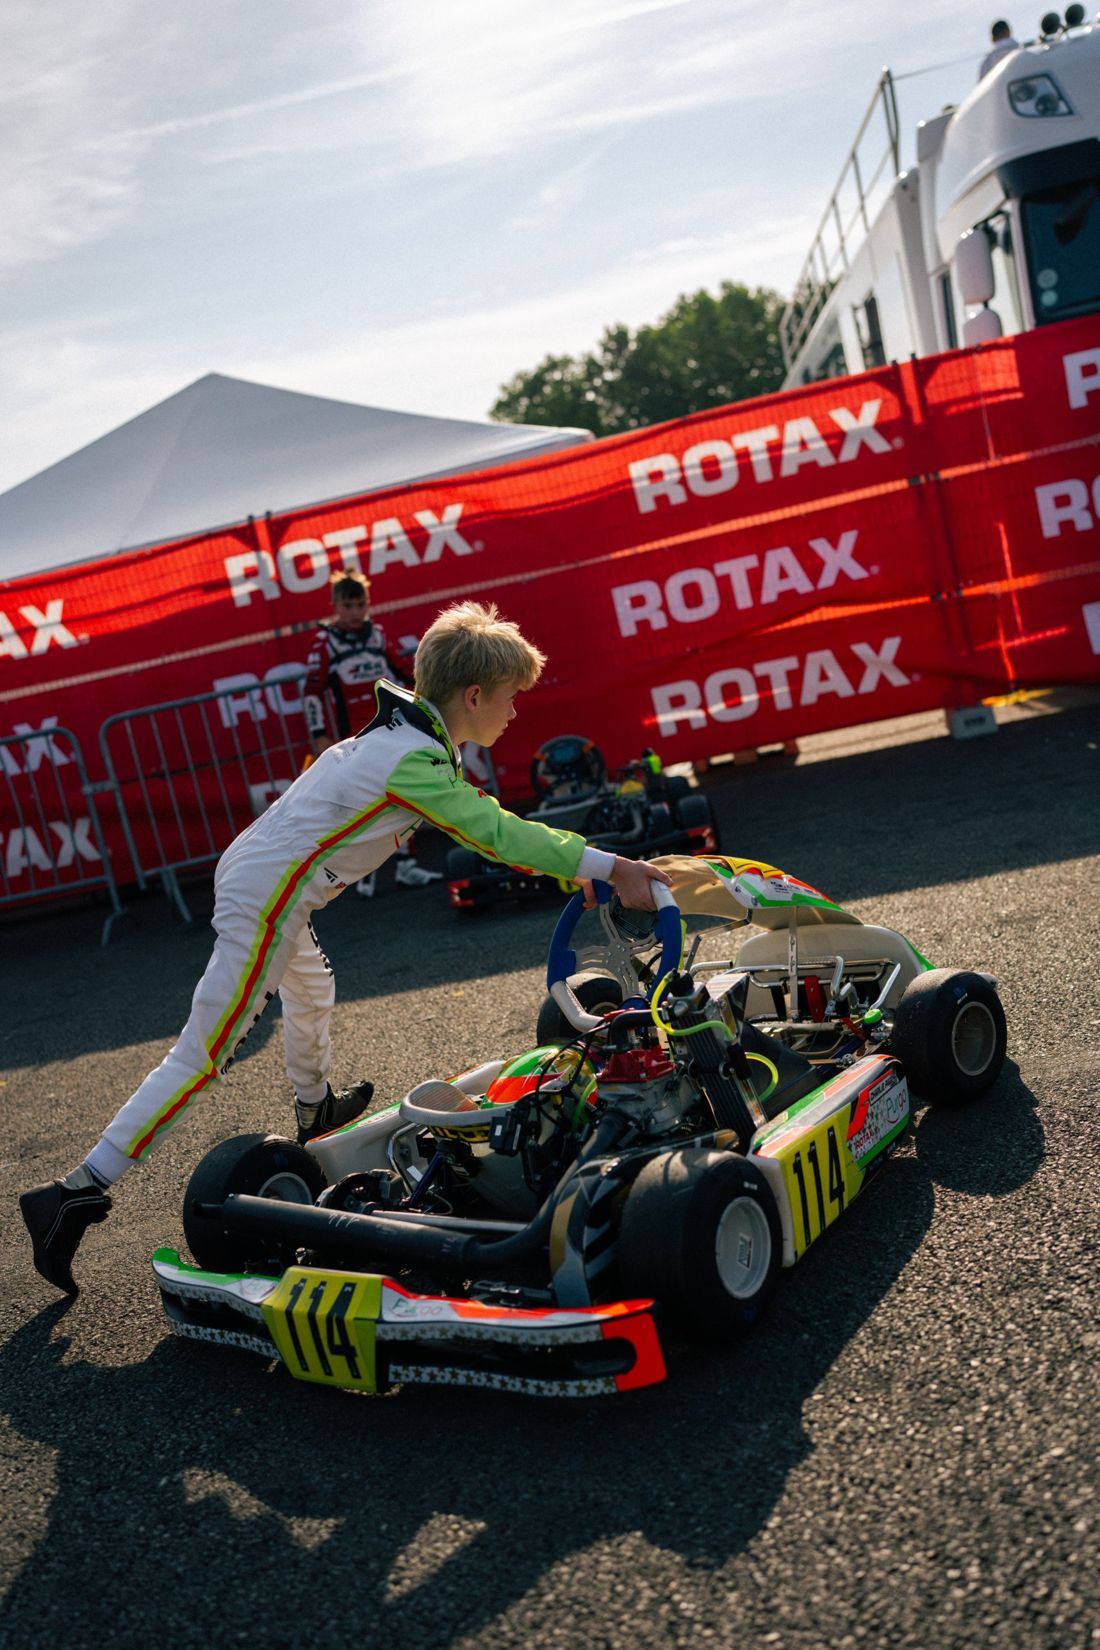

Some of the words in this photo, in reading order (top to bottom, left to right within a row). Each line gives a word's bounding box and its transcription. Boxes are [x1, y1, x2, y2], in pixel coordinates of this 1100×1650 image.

[628, 400, 892, 514] ROTAX
[224, 503, 474, 608] ROTAX
[611, 530, 868, 638] ROTAX
[650, 637, 910, 738] ROTAX
[793, 1126, 845, 1246] 114
[285, 1278, 361, 1379] 114
